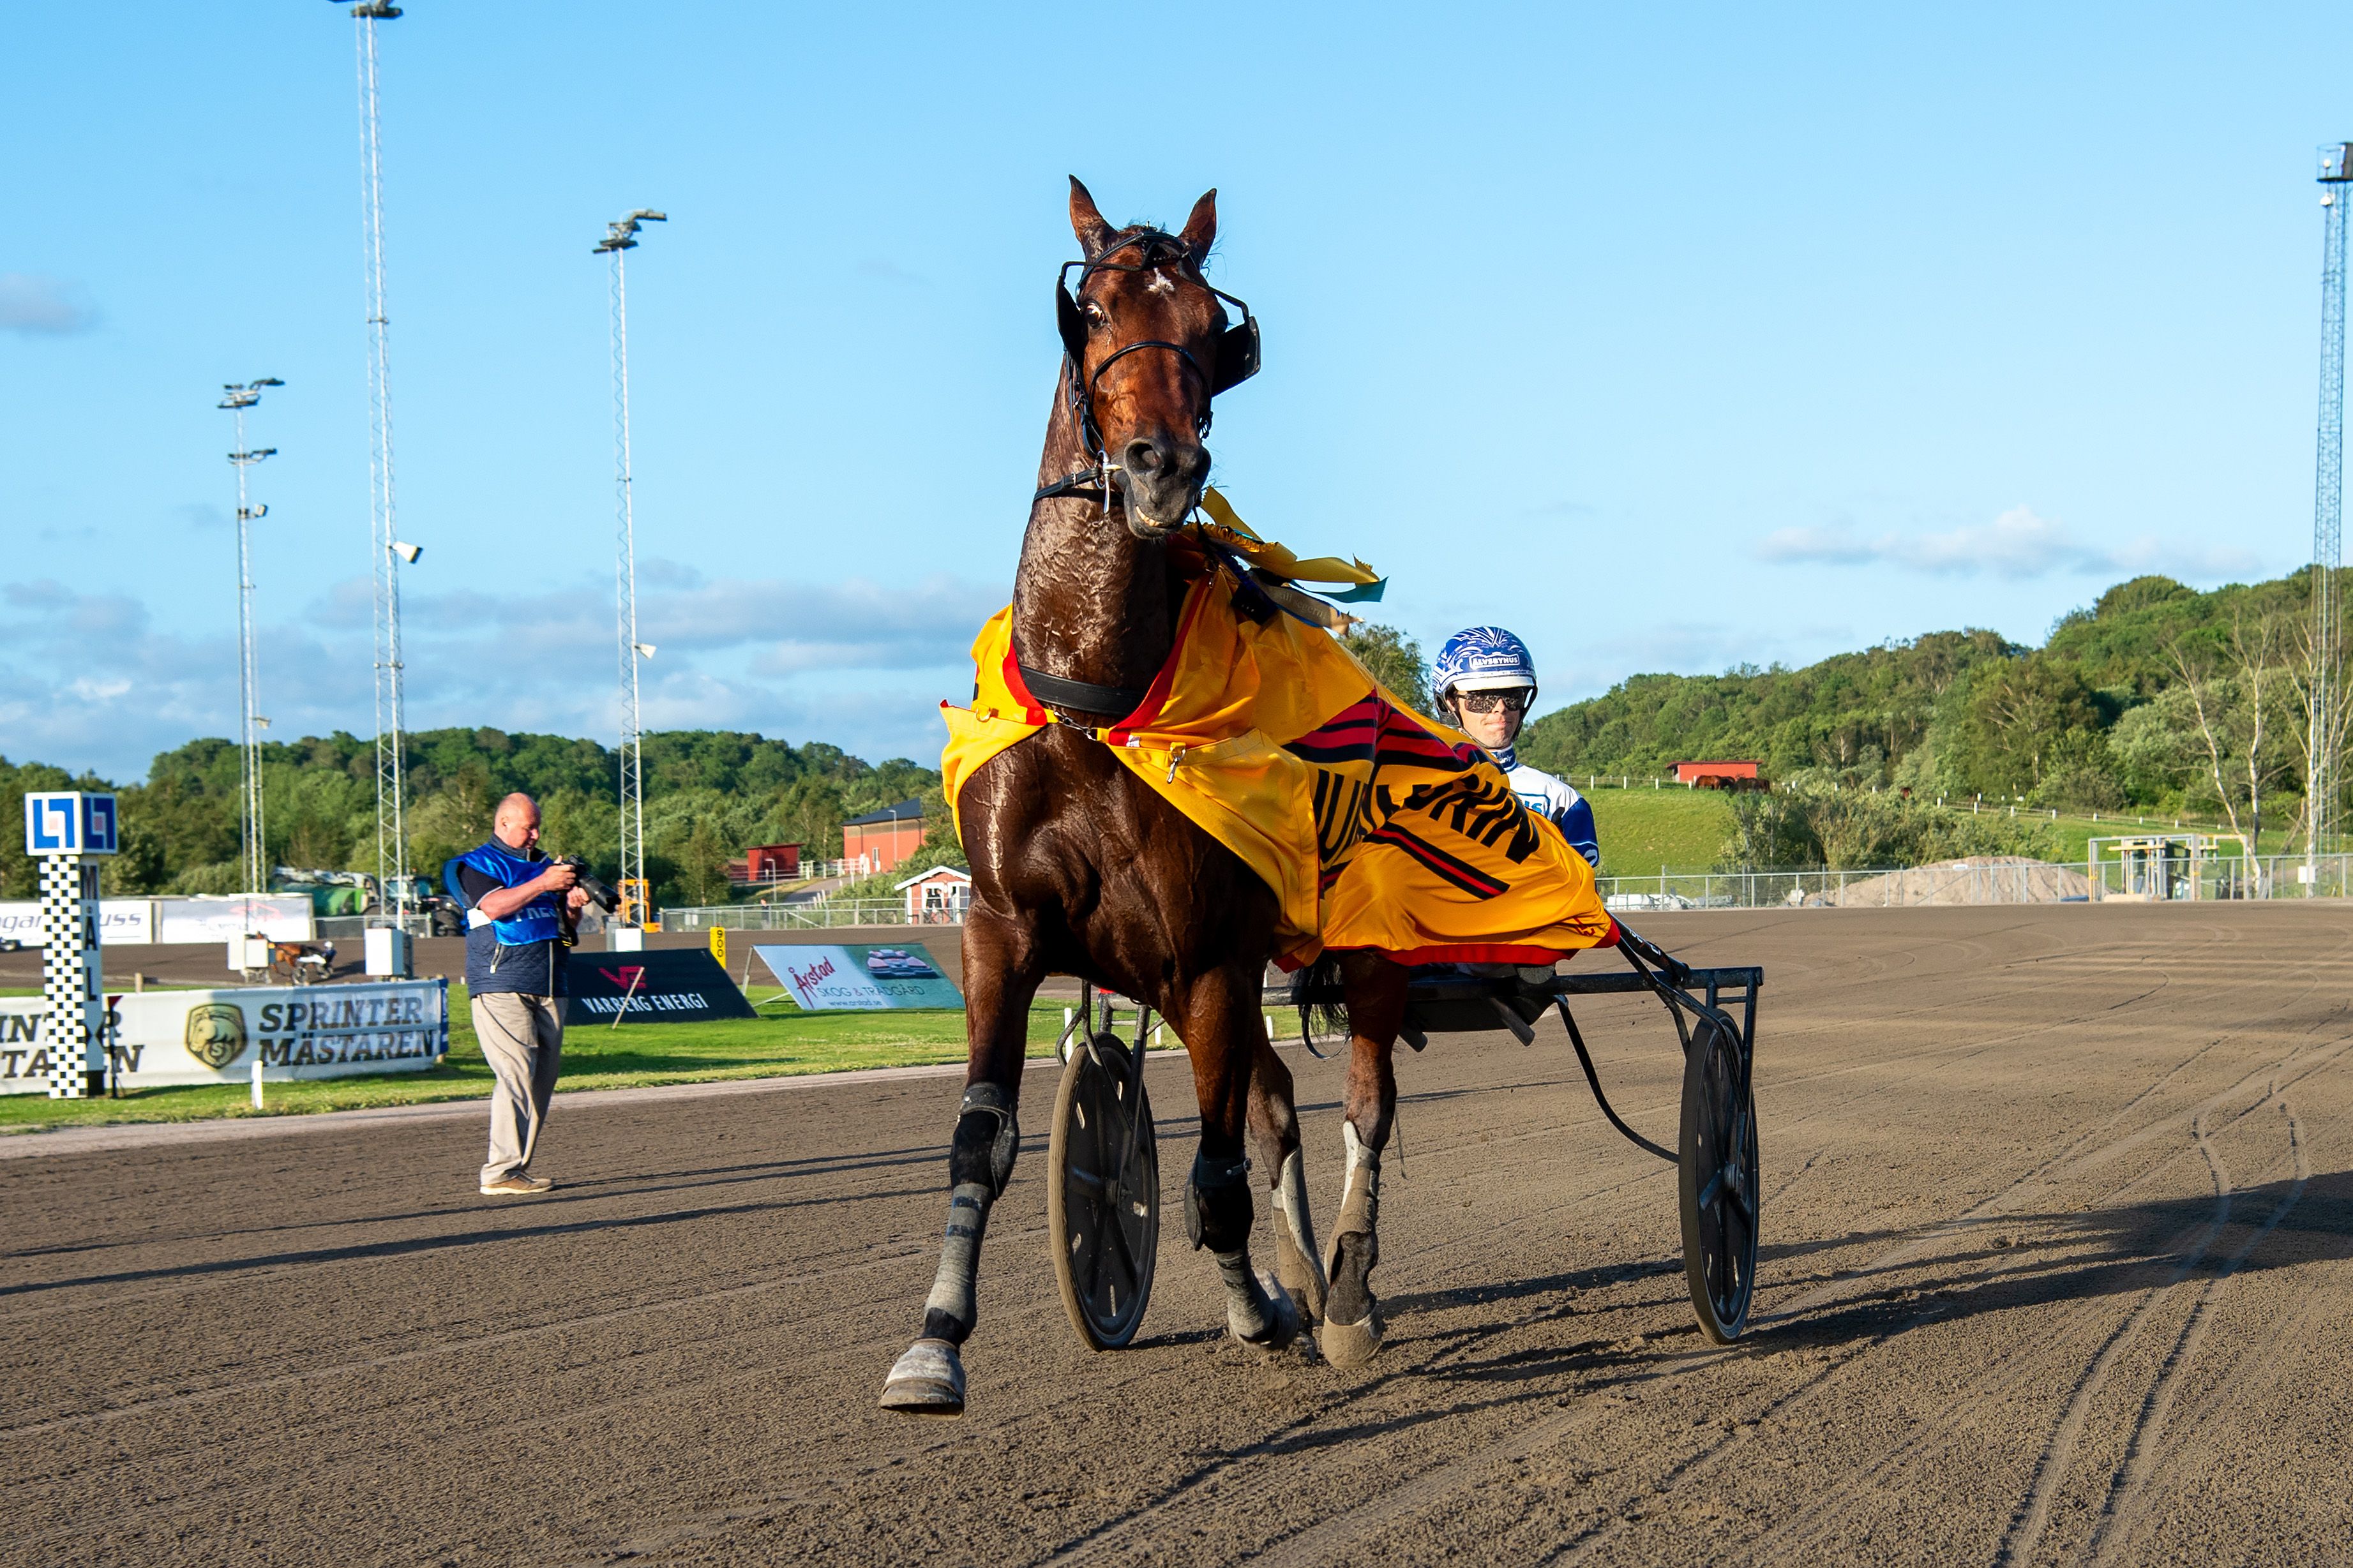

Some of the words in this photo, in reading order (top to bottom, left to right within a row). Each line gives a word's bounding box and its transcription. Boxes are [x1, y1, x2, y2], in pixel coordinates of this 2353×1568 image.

[79, 865, 99, 1002] MÅL
[788, 955, 836, 1011] Årstad
[816, 987, 853, 997] SKOG
[854, 987, 862, 996] &
[259, 996, 423, 1033] SPRINTER
[582, 995, 652, 1013] VARBERG
[650, 993, 709, 1011] ENERGI
[259, 1029, 438, 1068] MÄSTAREN
